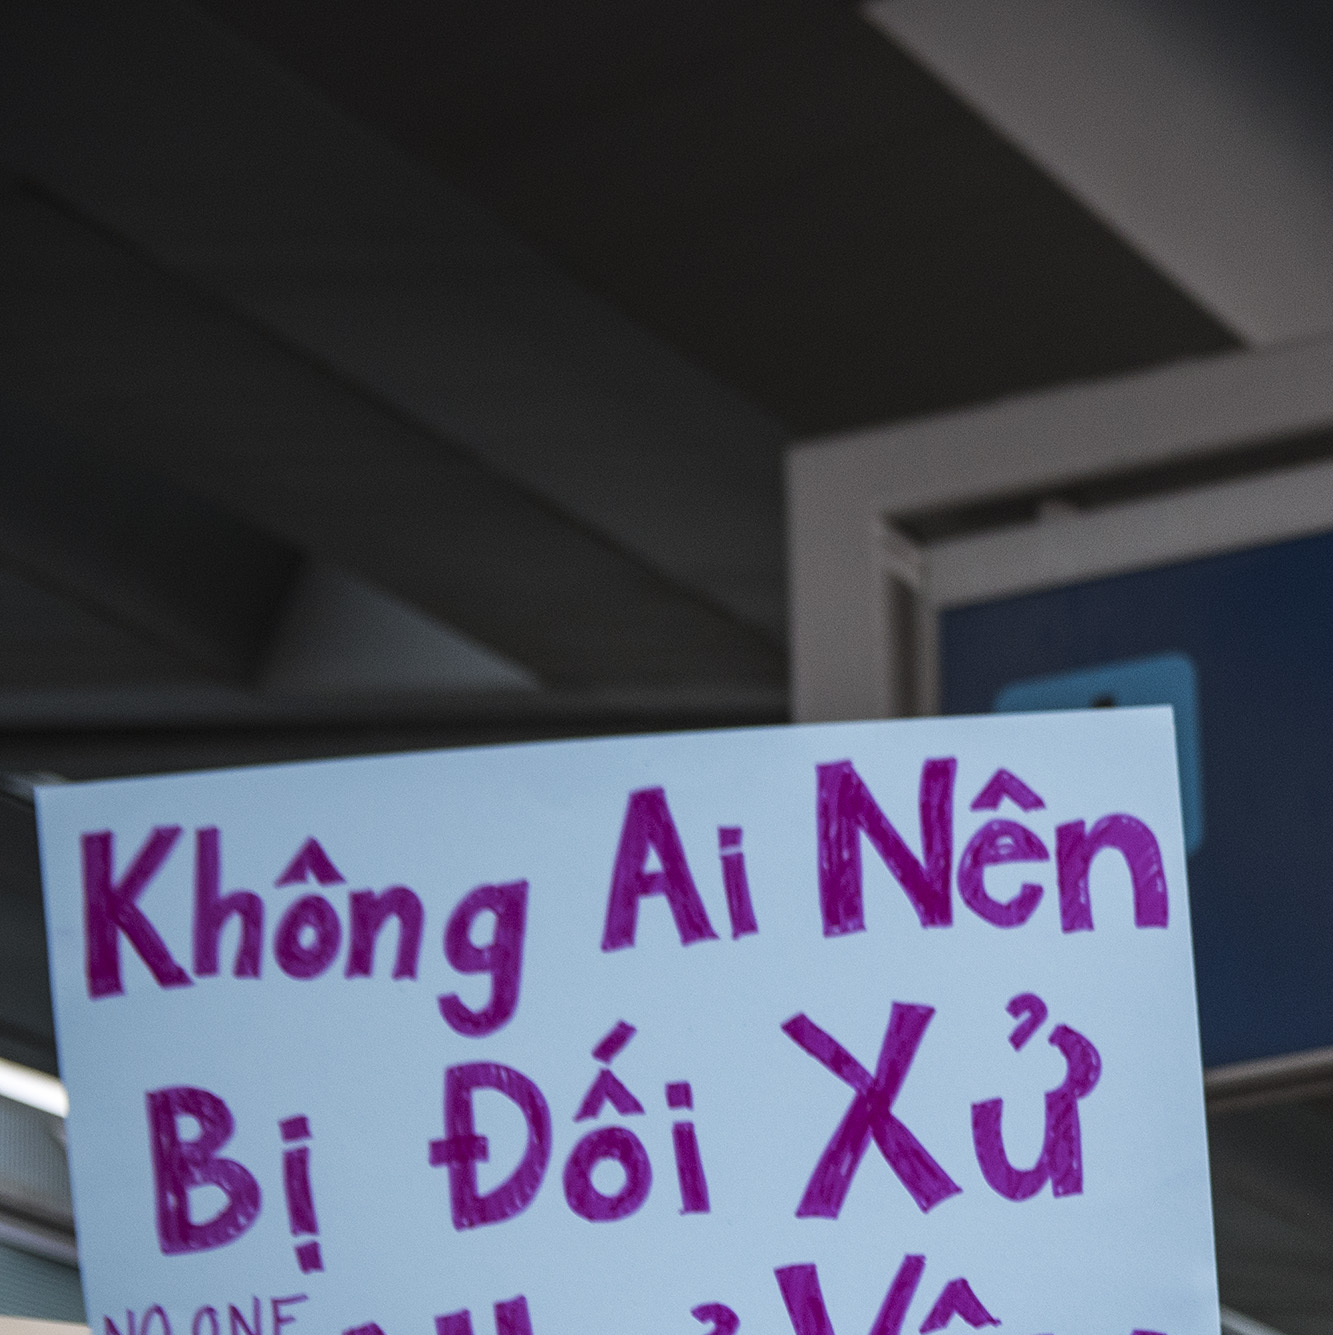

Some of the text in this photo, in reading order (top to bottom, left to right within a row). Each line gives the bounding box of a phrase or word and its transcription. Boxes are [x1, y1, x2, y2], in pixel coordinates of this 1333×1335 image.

[82, 757, 1169, 1037] Không Ai Nên
[146, 993, 1101, 1273] Bị Đối Xử
